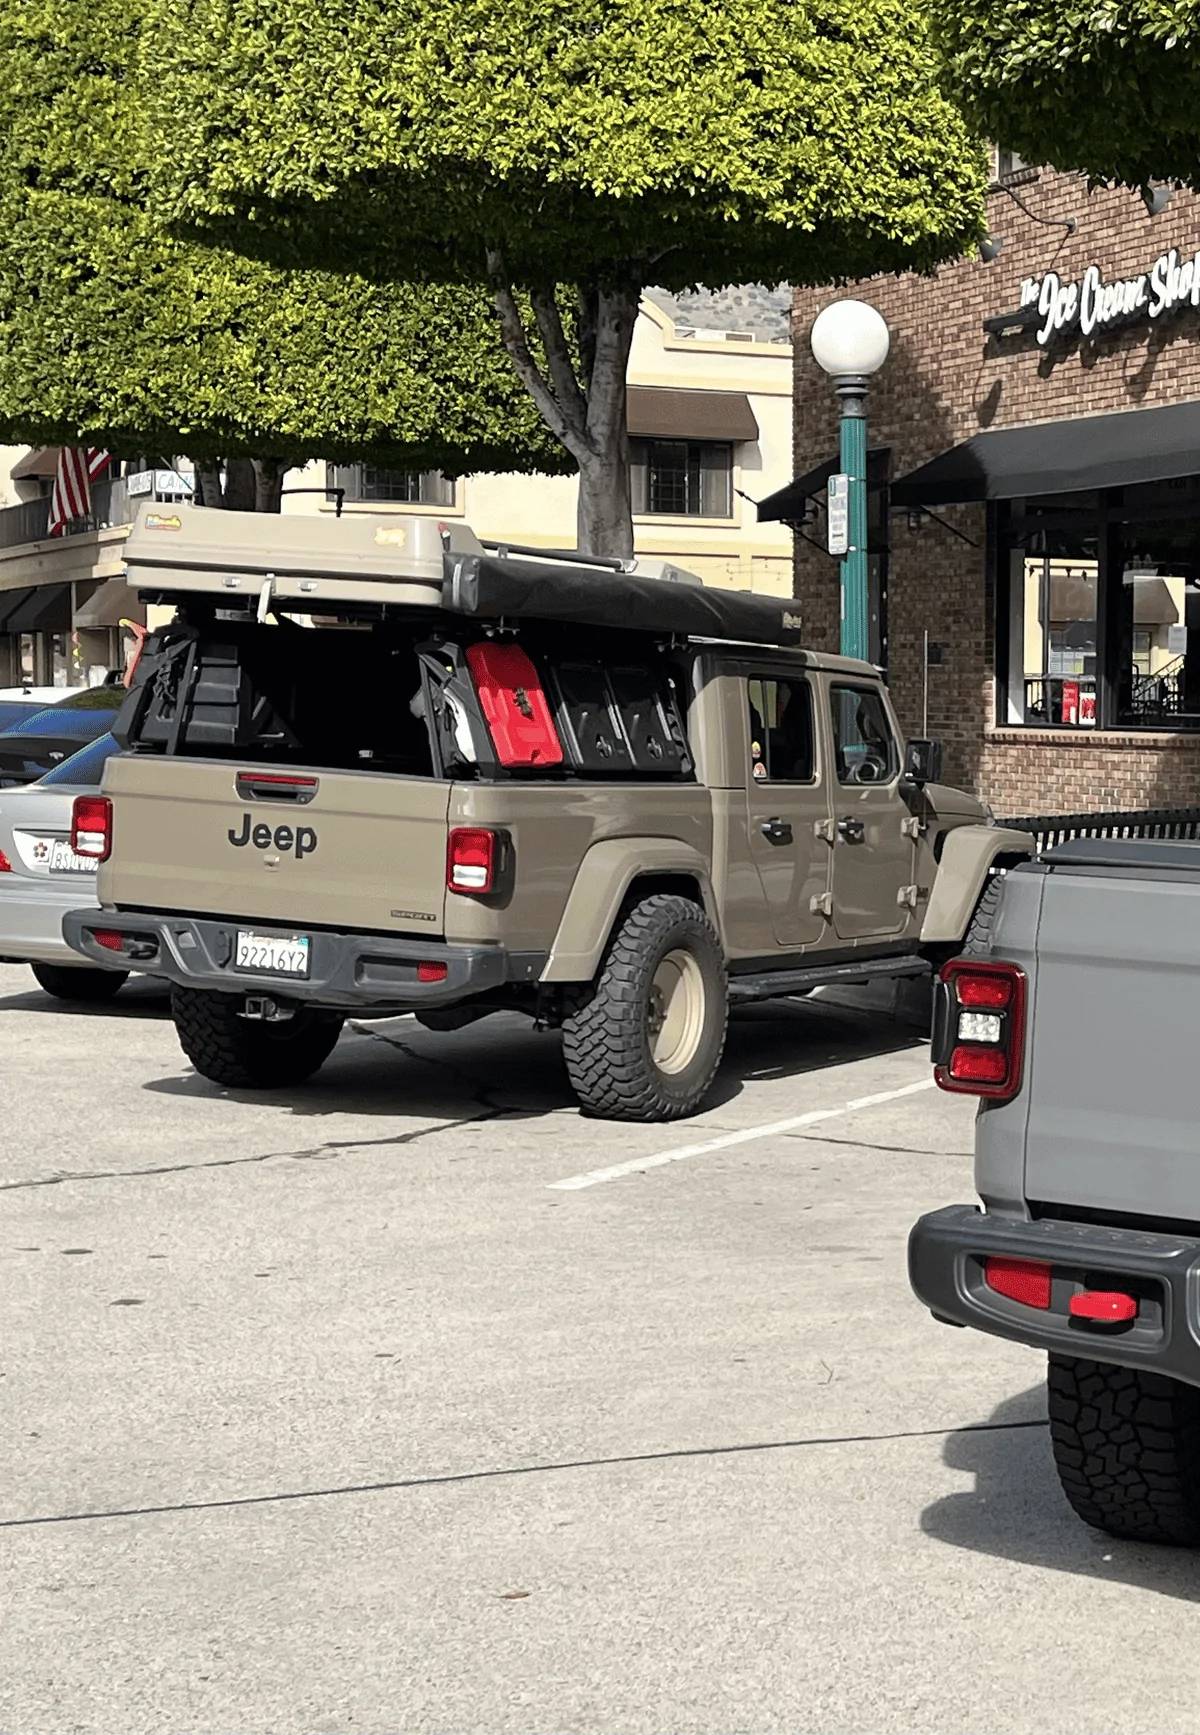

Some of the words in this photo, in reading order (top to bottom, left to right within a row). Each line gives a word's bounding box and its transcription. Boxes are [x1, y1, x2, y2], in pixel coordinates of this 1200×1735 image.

[1020, 276, 1040, 307] The
[1036, 272, 1078, 346] Ice
[1080, 264, 1149, 337] Cream
[228, 812, 318, 860] Jeep
[240, 945, 306, 973] 92216Y2
